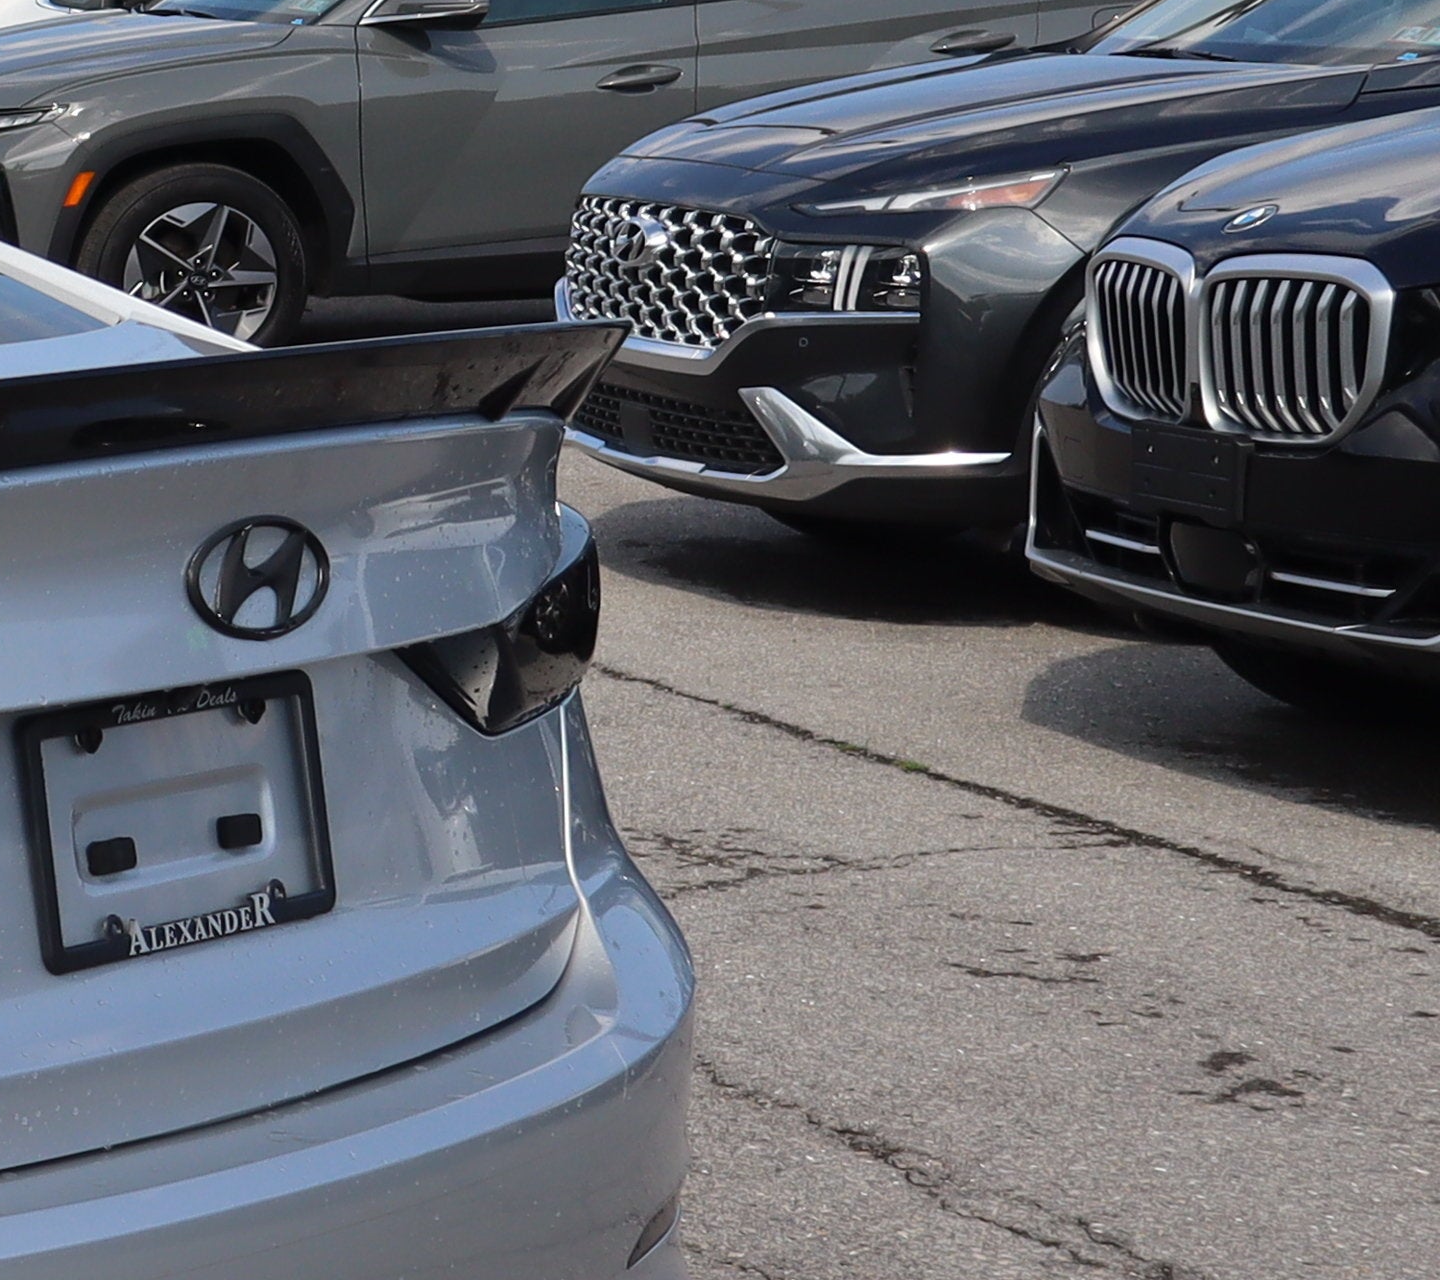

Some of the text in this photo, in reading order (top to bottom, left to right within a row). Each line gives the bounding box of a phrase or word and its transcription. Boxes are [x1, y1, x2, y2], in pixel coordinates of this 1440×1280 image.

[112, 701, 158, 724] Takin
[196, 687, 238, 709] Deals
[128, 891, 277, 957] ALEXANDER
